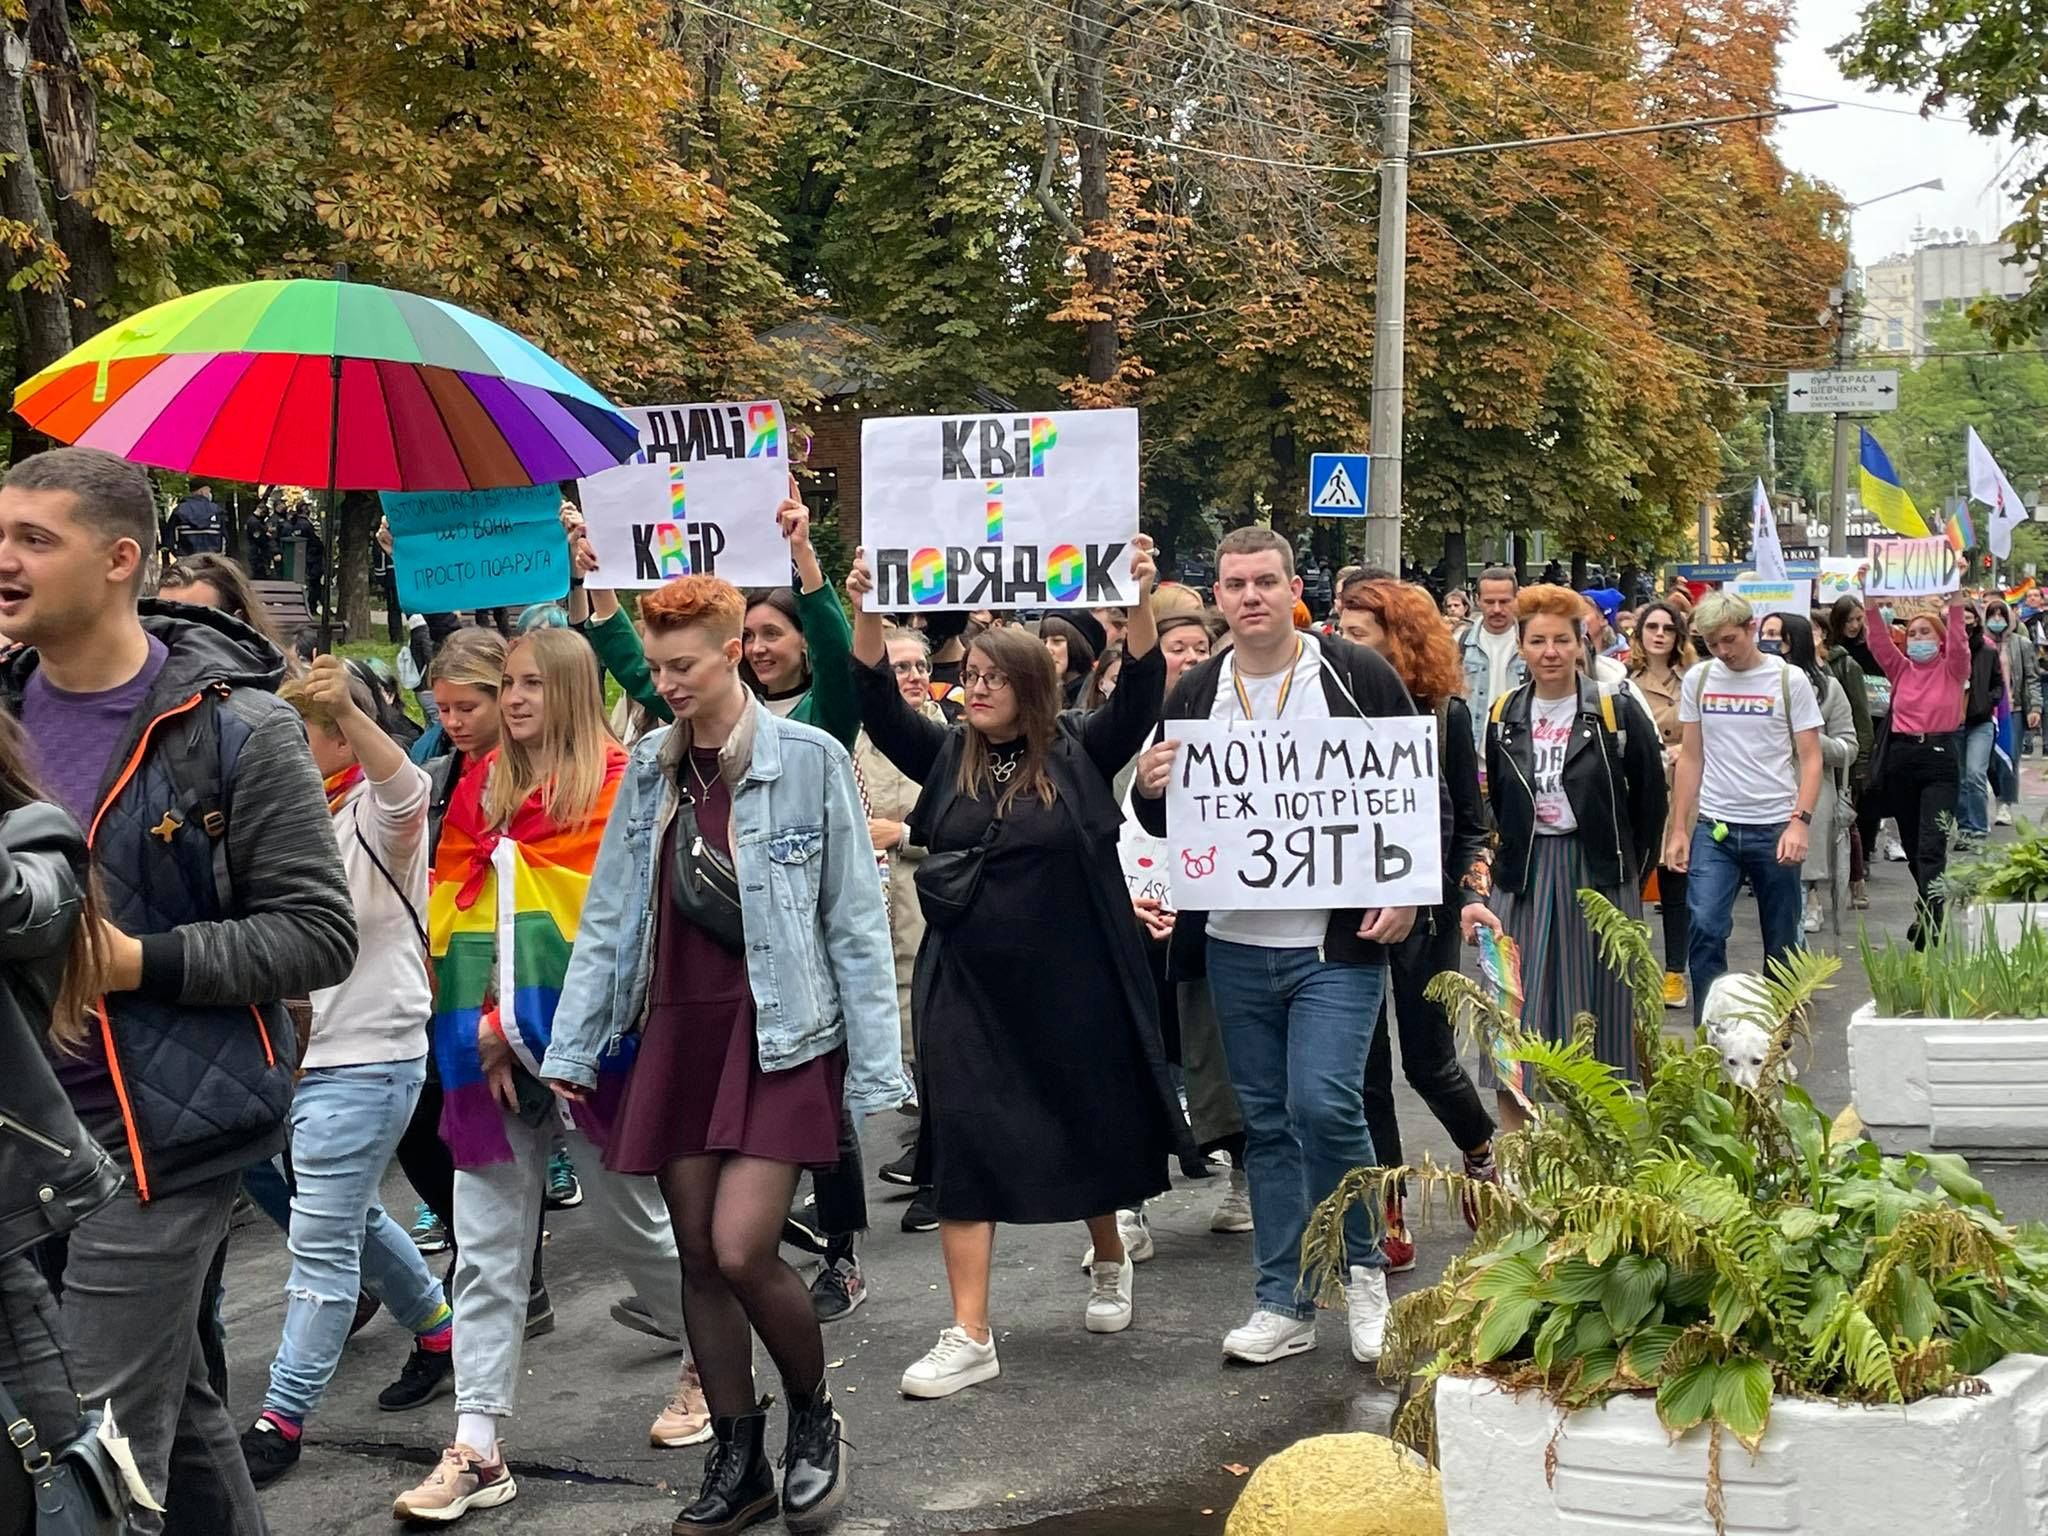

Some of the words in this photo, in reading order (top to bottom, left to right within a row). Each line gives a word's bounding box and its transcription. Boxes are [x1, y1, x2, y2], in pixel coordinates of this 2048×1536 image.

[1810, 385, 1867, 394] ШЕВЧЕНКА
[1834, 375, 1877, 384] ТАРАСА
[414, 561, 475, 592] ПРОСТО
[481, 550, 551, 578] ПОДРУГА
[876, 543, 1128, 606] ПОРЯДОК
[1902, 539, 1956, 591] KIND
[1182, 730, 1300, 788] МОЇЙ
[1193, 791, 1257, 822] ТЕЖ
[1238, 822, 1413, 889] ЗЯТЬ
[1140, 879, 1171, 906] ASK
